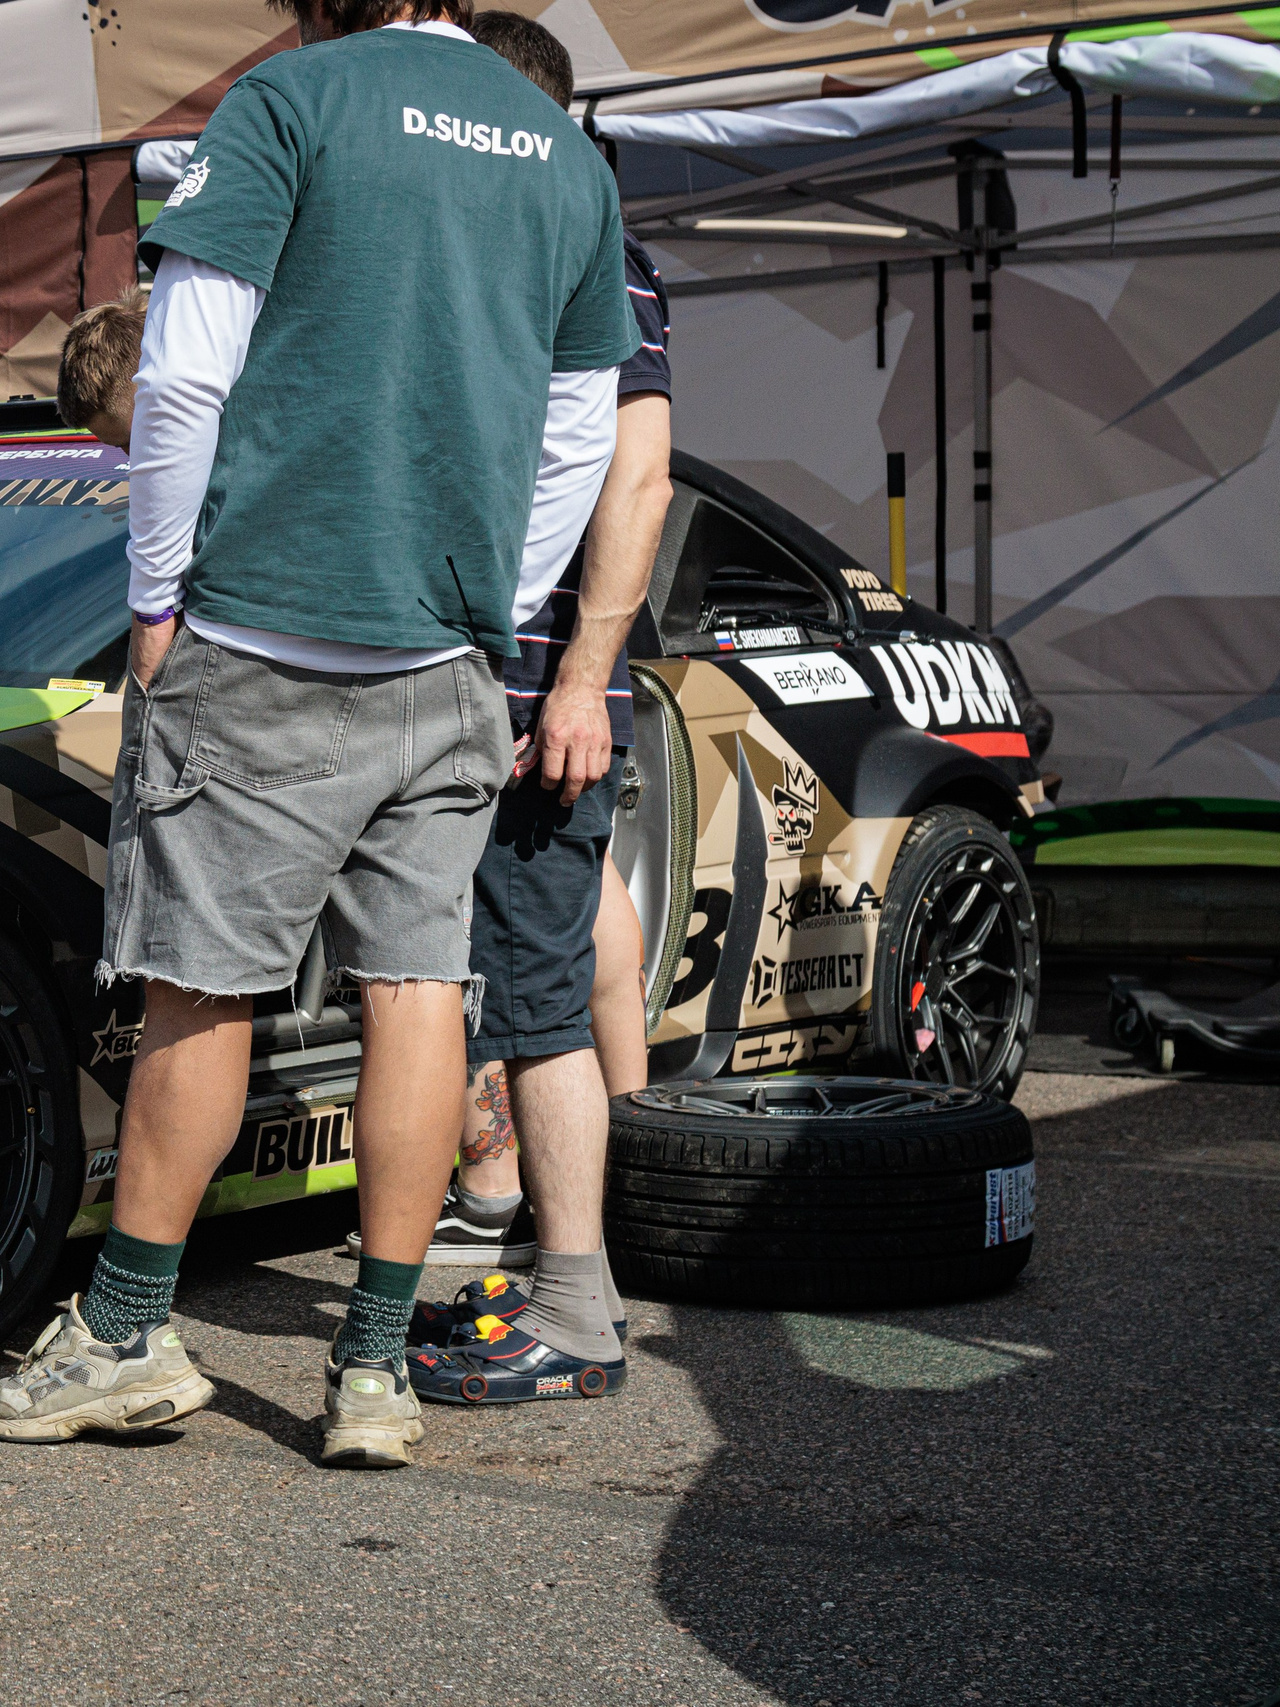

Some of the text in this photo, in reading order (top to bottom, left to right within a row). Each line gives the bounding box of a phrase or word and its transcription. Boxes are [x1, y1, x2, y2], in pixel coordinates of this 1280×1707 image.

[402, 107, 553, 161] D.SUSLOV
[839, 568, 882, 590] YOYO
[857, 591, 904, 613] TIRES
[730, 630, 743, 650] E.
[773, 664, 847, 692] BERKANO
[870, 640, 1021, 731] UDKM
[801, 881, 883, 918] GKA
[780, 953, 864, 996] TESSERACT
[536, 1374, 573, 1385] ORACLE
